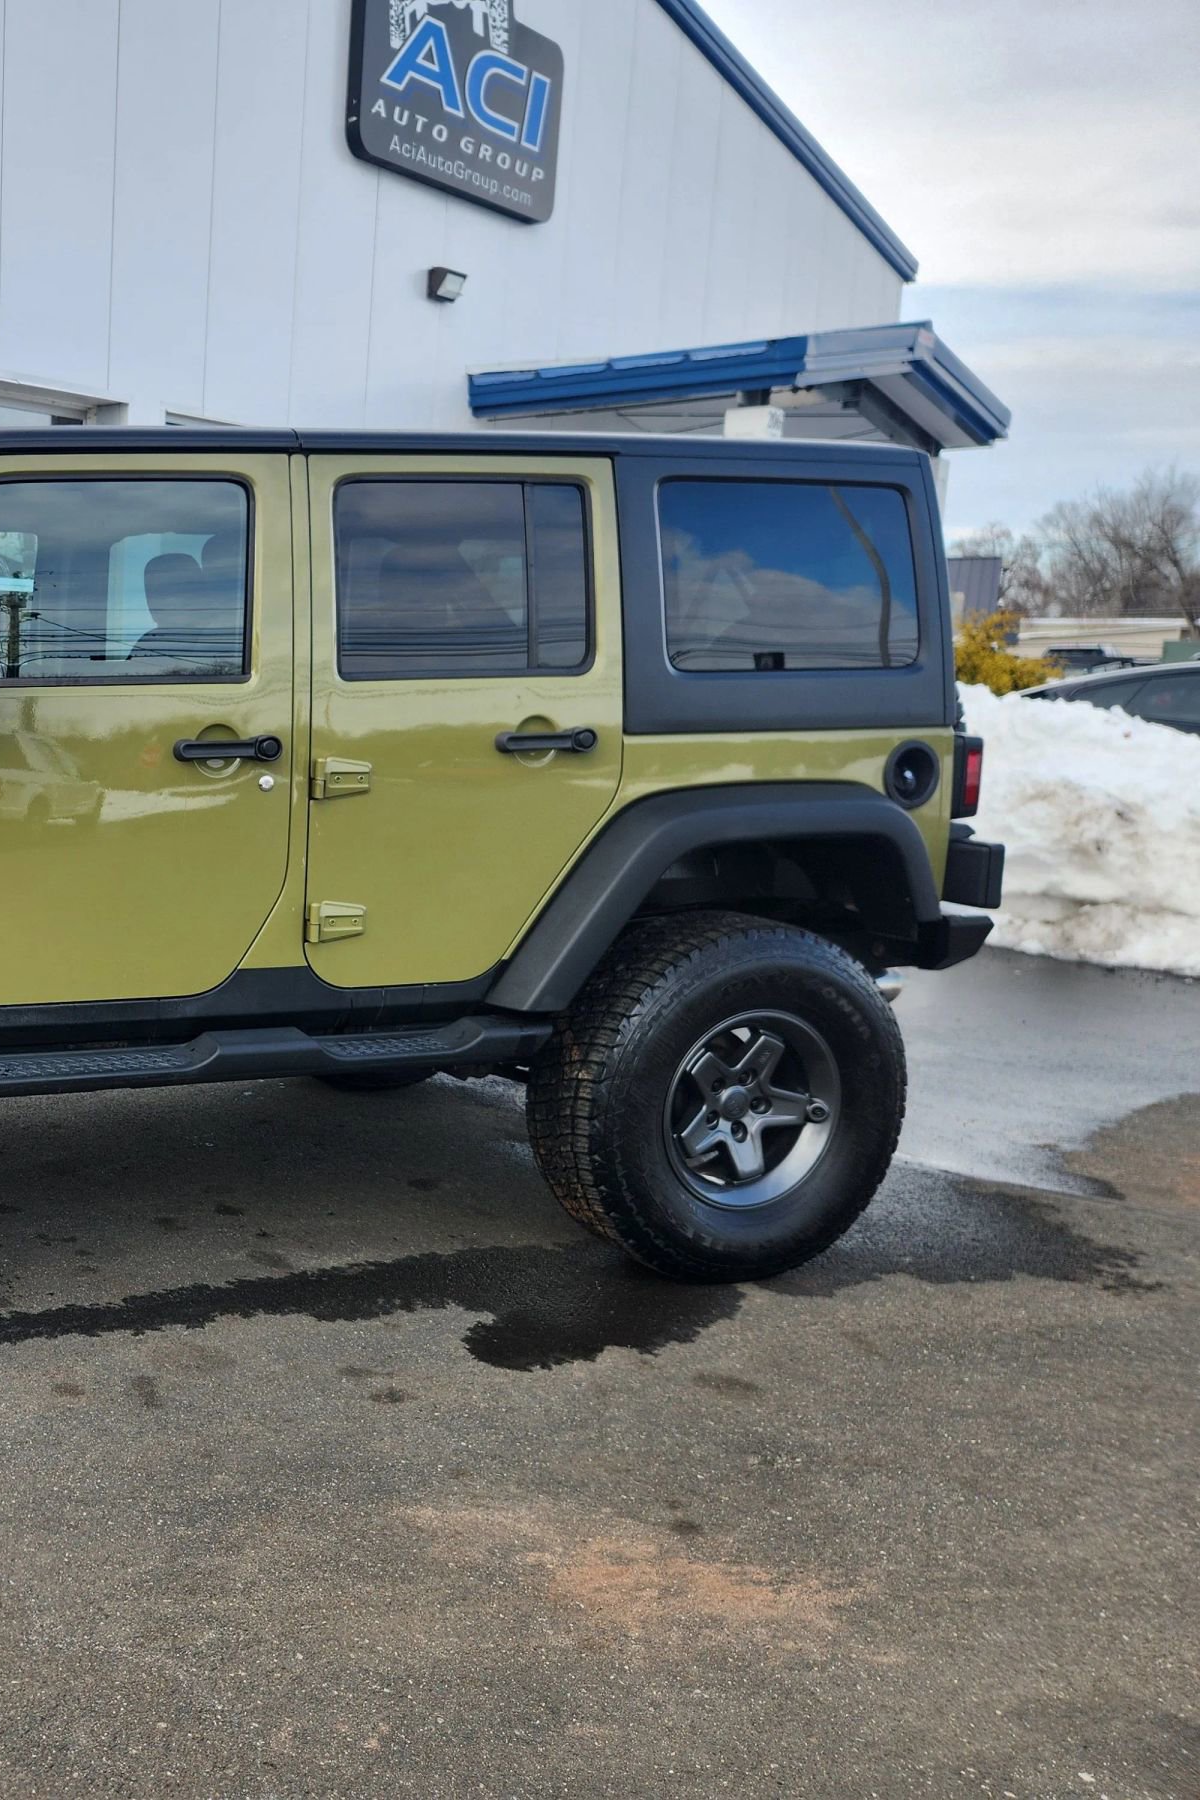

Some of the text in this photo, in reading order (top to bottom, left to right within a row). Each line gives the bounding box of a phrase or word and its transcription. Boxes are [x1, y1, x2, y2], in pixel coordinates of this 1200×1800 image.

[379, 14, 551, 153] ACI
[371, 98, 545, 182] AUTO GROUP
[389, 135, 533, 206] AciAutoGroup.com
